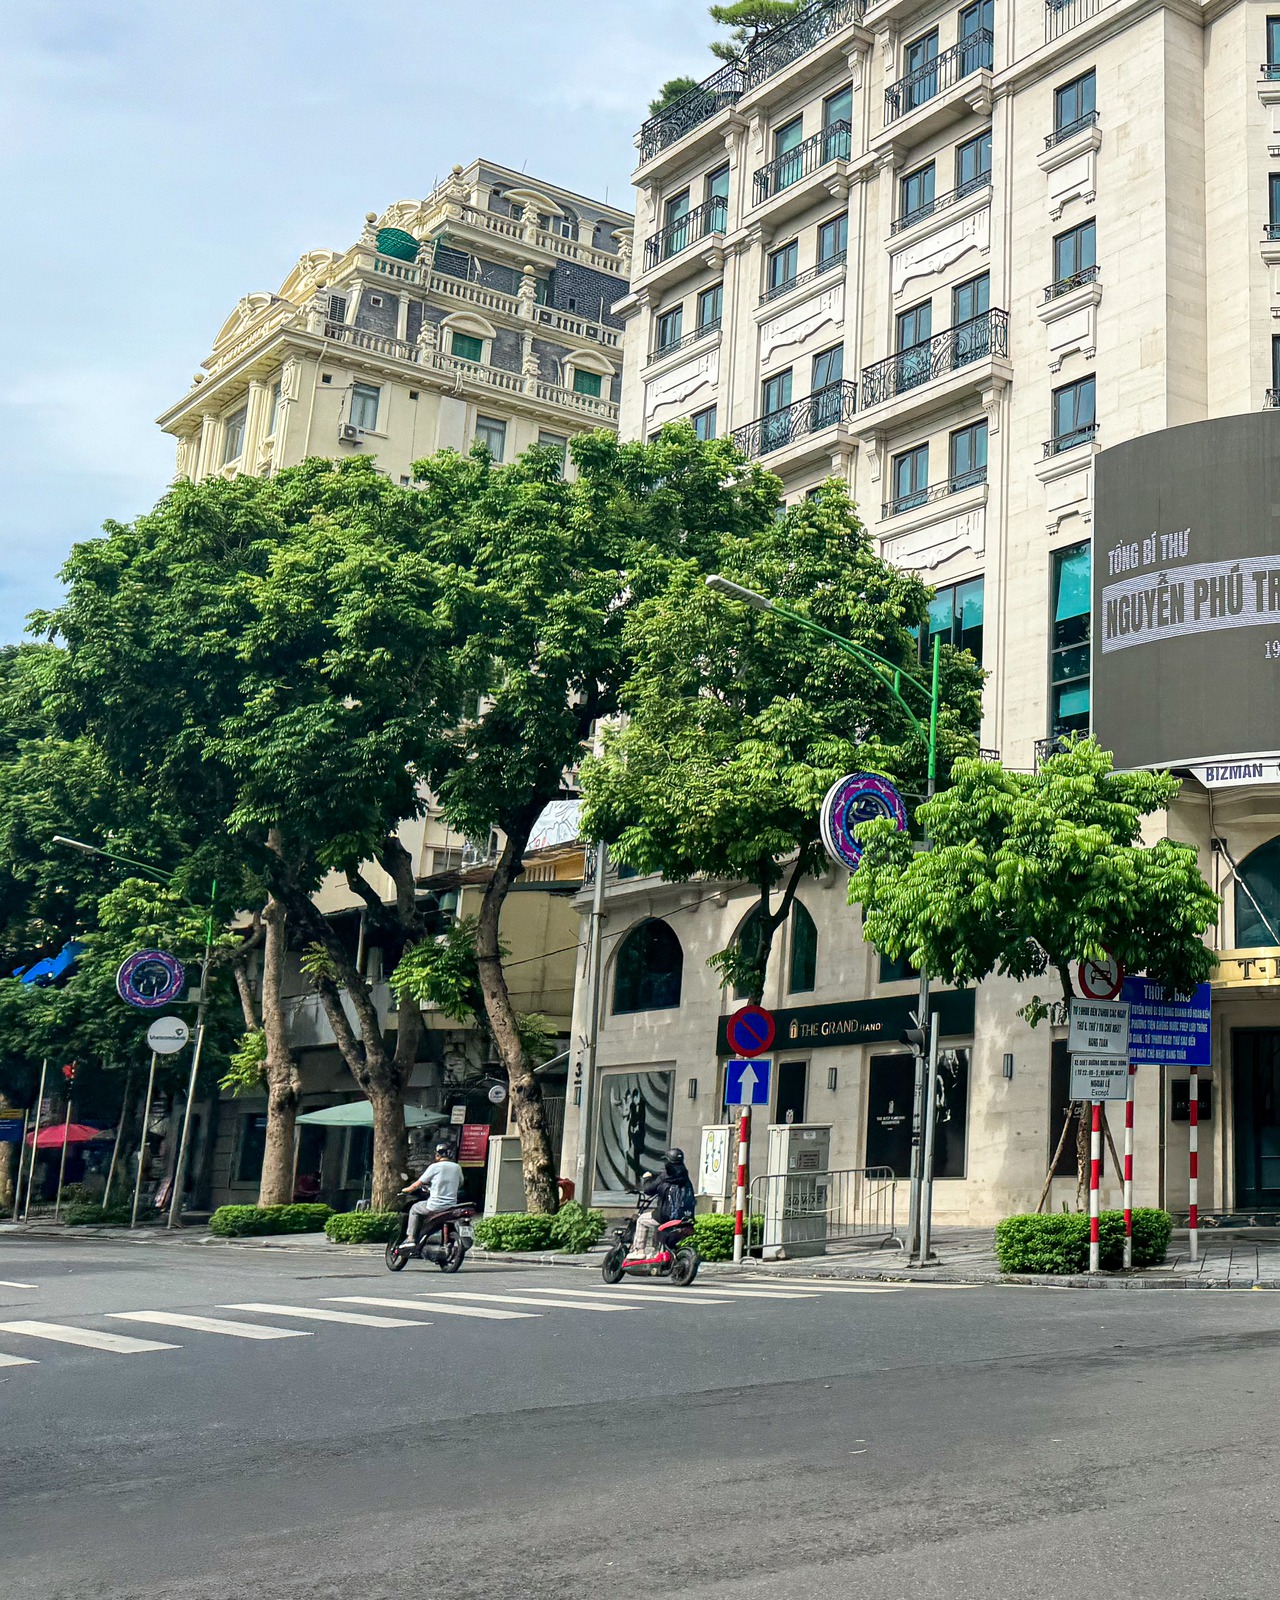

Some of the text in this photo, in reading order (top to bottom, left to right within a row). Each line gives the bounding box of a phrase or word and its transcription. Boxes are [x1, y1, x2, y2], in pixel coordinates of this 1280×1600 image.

[1107, 539, 1139, 576] TỔNG
[1143, 531, 1157, 566] BÍ
[1106, 572, 1185, 640] NGUYỄN
[1194, 563, 1244, 621] PHÚ
[1205, 762, 1263, 782] BIZMAN
[800, 1022, 820, 1037] THE
[821, 1019, 859, 1036] GRAND
